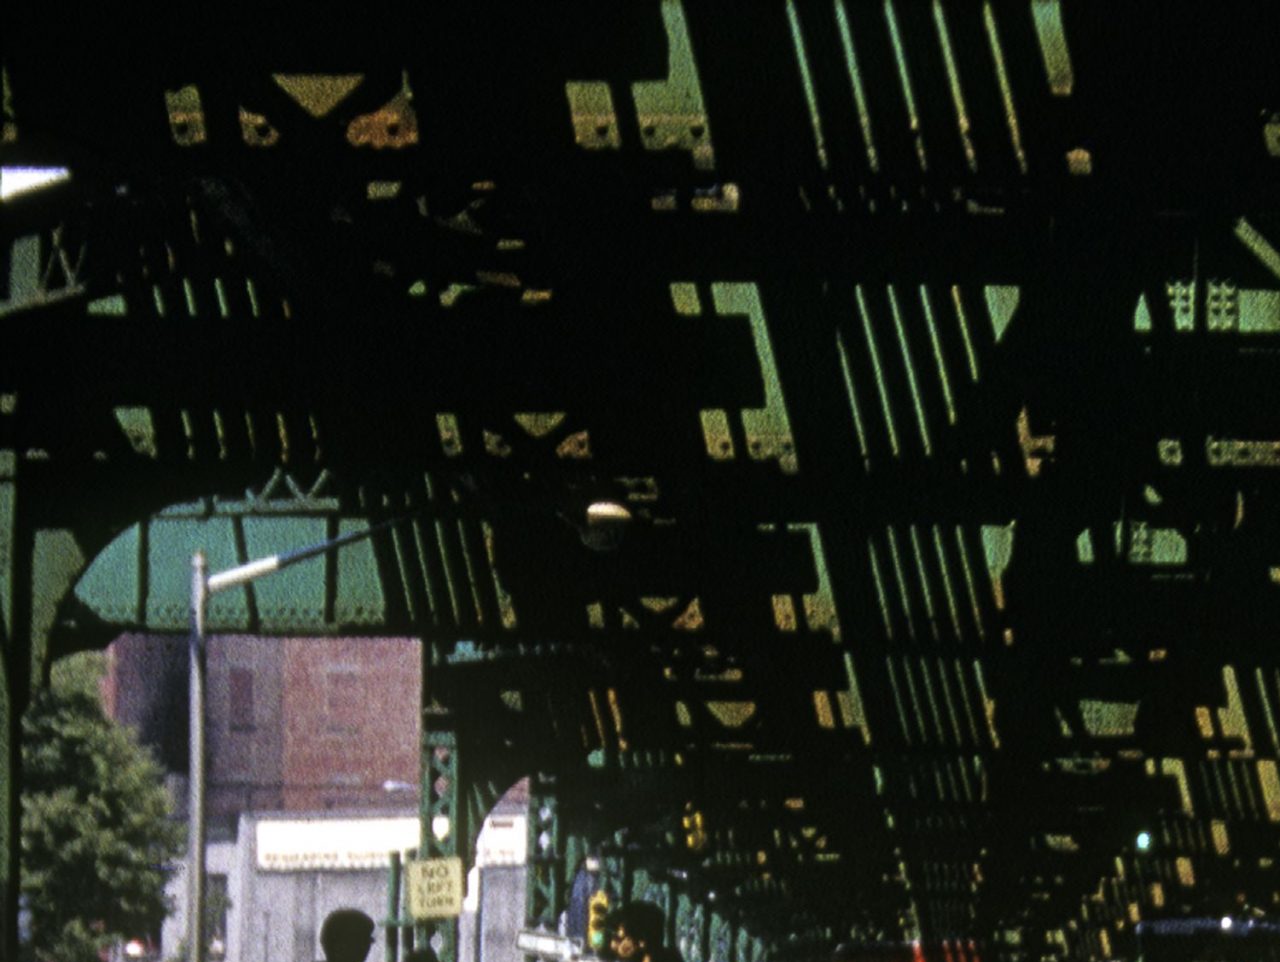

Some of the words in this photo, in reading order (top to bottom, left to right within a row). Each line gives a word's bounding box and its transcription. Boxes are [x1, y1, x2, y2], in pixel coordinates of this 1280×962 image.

[421, 864, 449, 878] NO
[417, 880, 453, 894] LEFT
[419, 896, 454, 908] TURN
